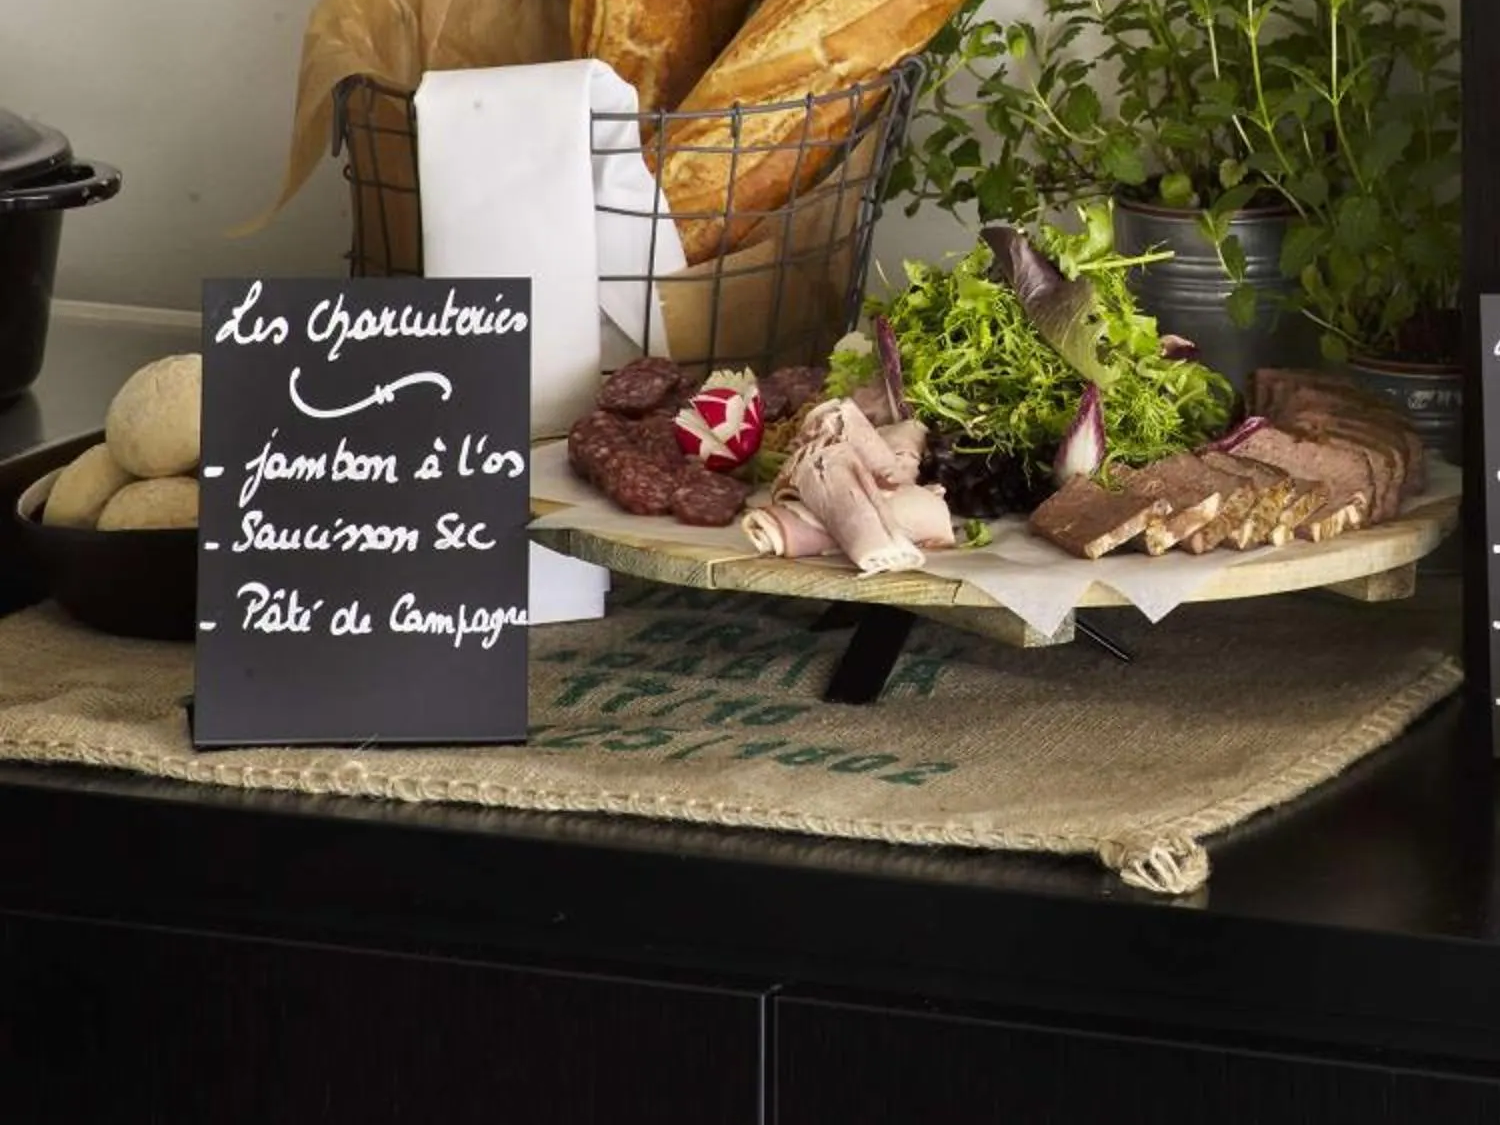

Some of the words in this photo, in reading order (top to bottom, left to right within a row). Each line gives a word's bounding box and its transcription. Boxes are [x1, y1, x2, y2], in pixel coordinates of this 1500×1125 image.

[214, 279, 289, 345] Les
[413, 436, 447, 480] à
[236, 581, 324, 634] Pâté
[329, 600, 373, 636] de
